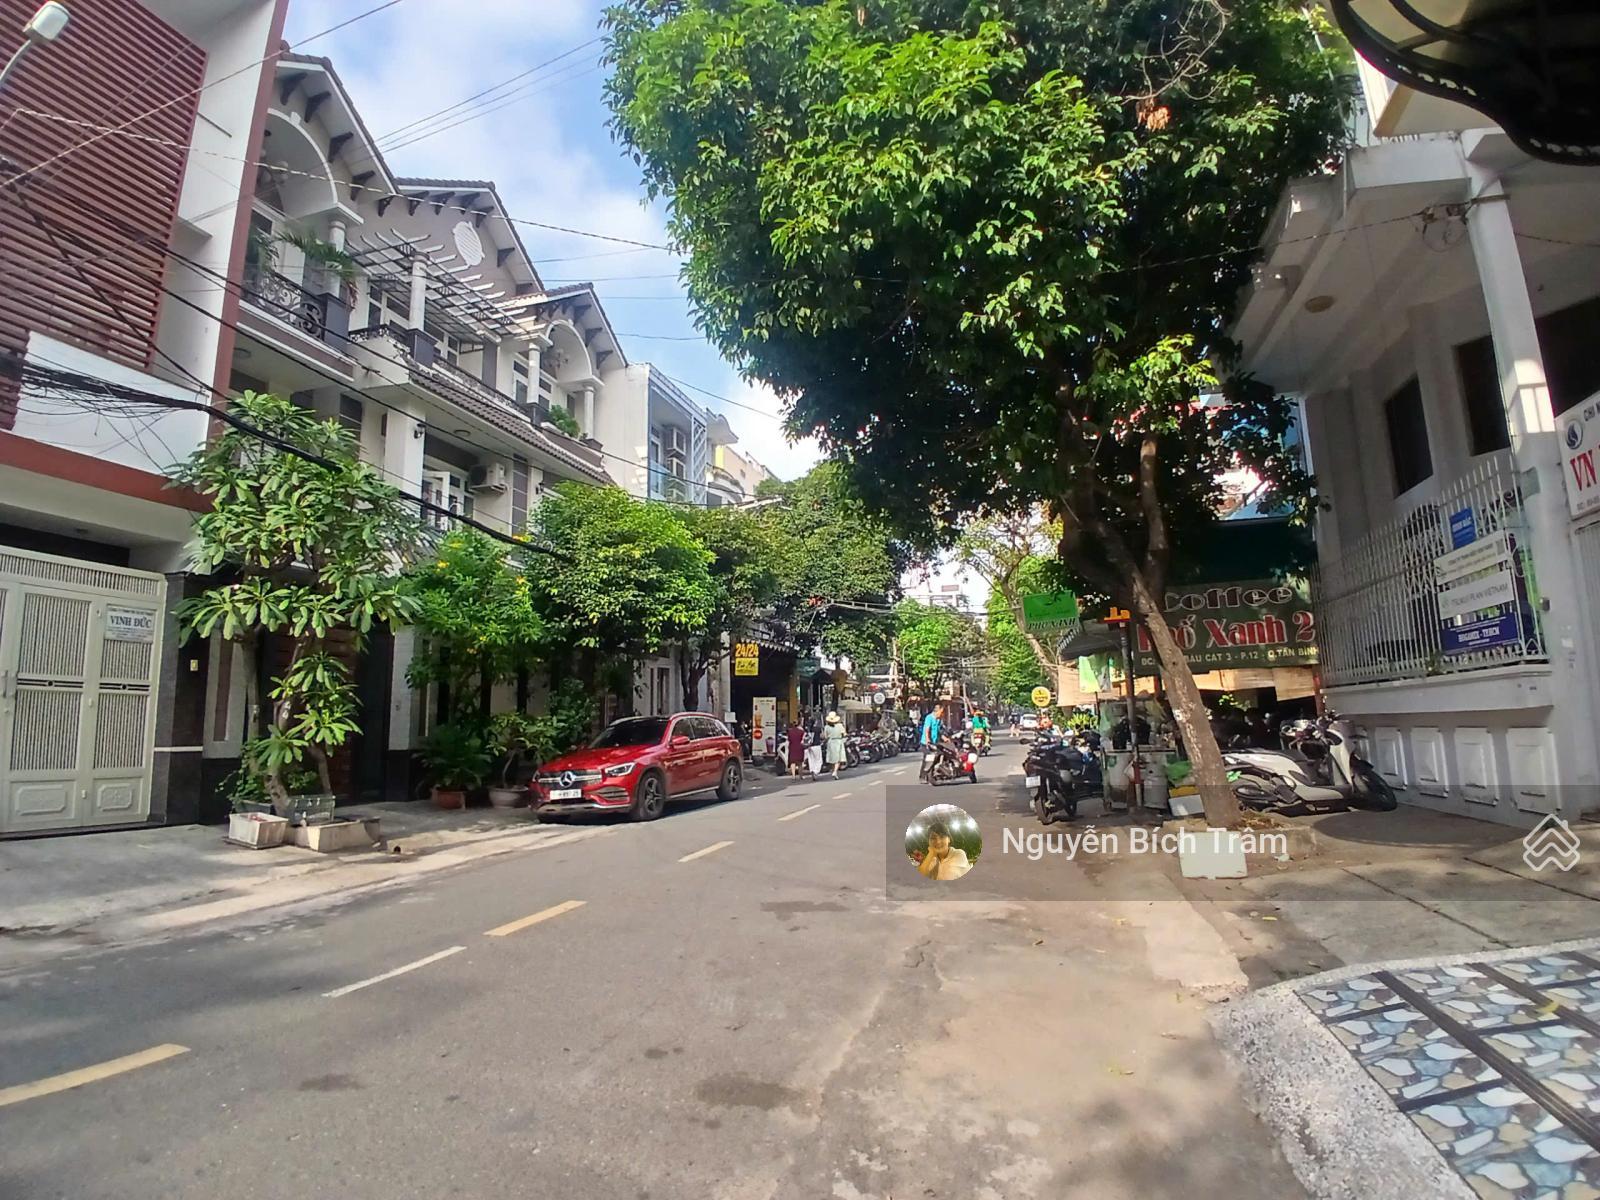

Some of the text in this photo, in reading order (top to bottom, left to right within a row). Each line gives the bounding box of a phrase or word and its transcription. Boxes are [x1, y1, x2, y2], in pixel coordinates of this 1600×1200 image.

[1137, 610, 1316, 652] Pố Xanh 2
[735, 643, 759, 657] 24/24
